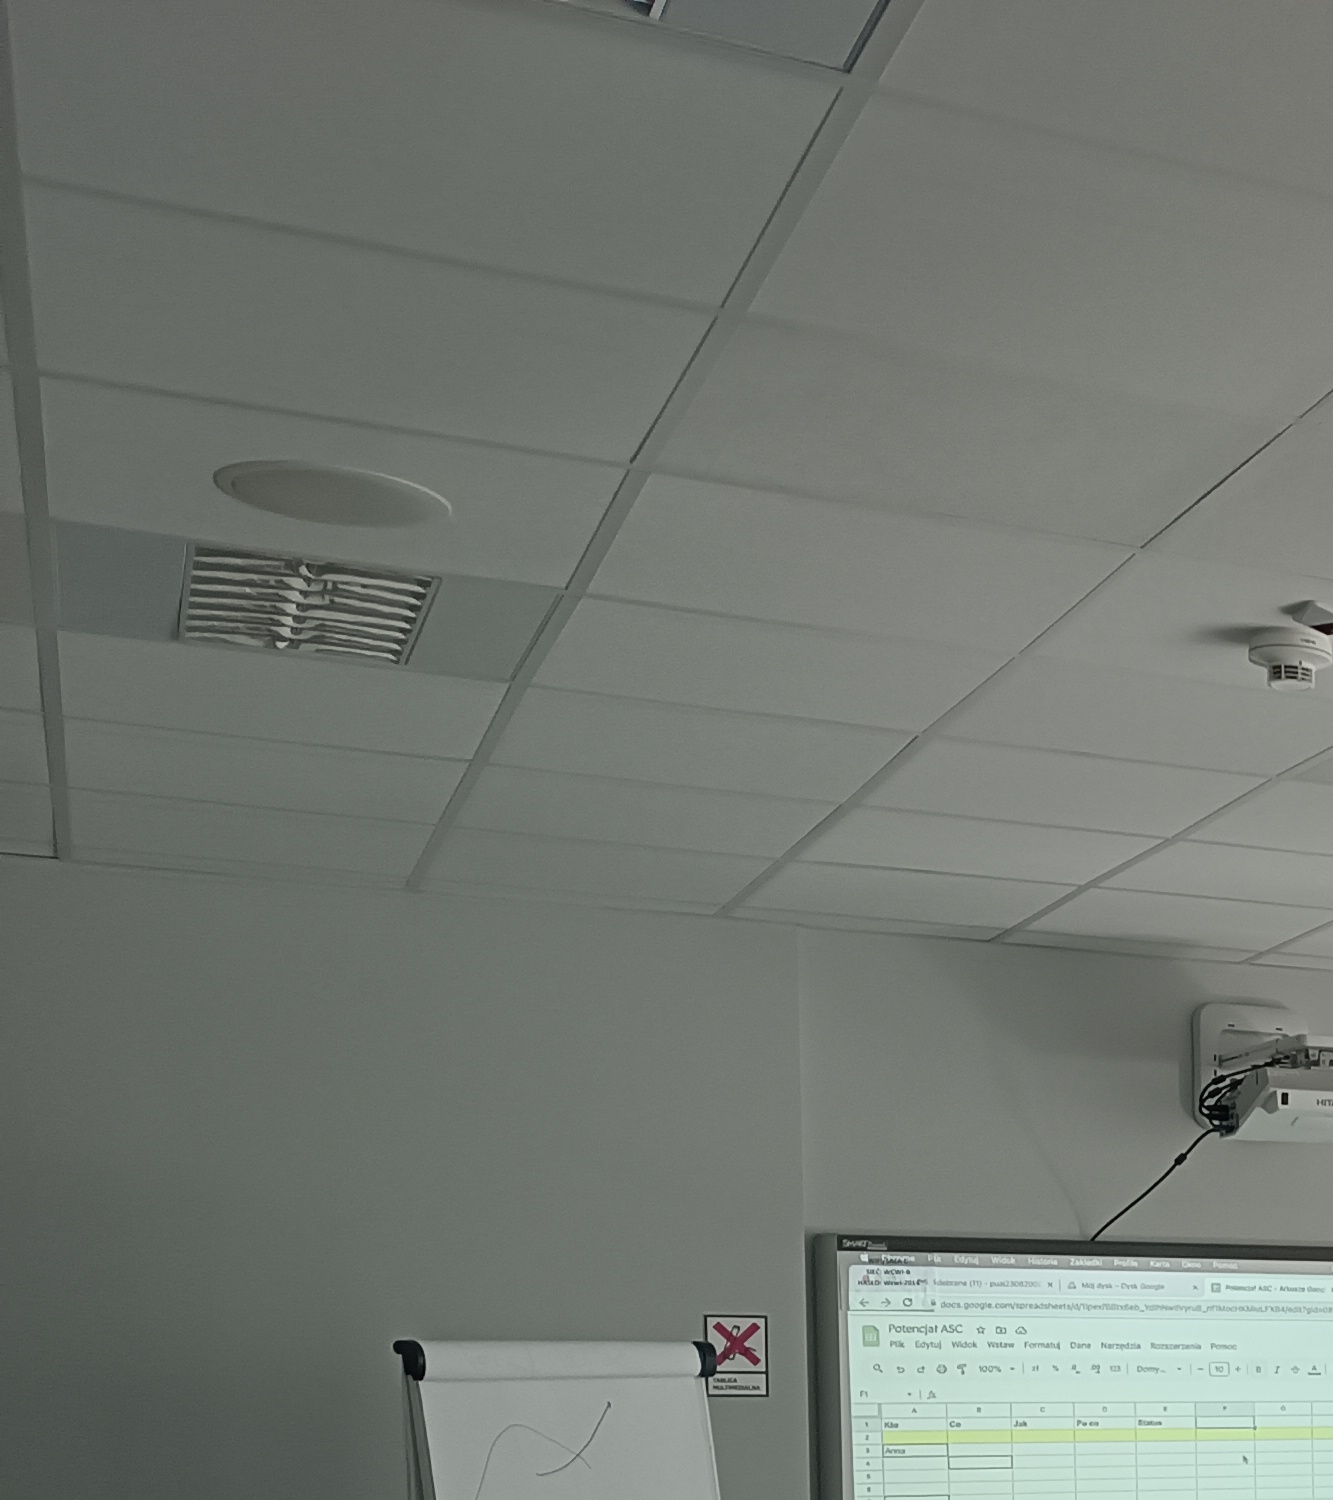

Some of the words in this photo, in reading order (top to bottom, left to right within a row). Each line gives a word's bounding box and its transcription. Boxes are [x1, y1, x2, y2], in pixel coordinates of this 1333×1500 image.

[954, 1255, 980, 1266] Edytuj
[990, 1256, 1016, 1265] Widok
[1027, 1257, 1059, 1266] Historia
[1113, 1258, 1139, 1268] Profile
[1150, 1259, 1171, 1269] Karta
[1140, 1282, 1165, 1292] Google
[888, 1324, 938, 1336] Potencjał
[940, 1324, 964, 1334] ASC
[889, 1340, 905, 1349] Plik
[914, 1341, 942, 1350] Edytuj
[951, 1341, 978, 1349] Widok
[987, 1341, 1015, 1349] Wstaw
[1023, 1341, 1061, 1351] Formatuj
[1100, 1341, 1142, 1351] Narzędzia
[1210, 1342, 1238, 1350] Pomoc
[978, 1365, 1002, 1374] 100%
[883, 1421, 899, 1429] Kto
[1013, 1420, 1028, 1428] Jak
[884, 1447, 906, 1455] Anna
